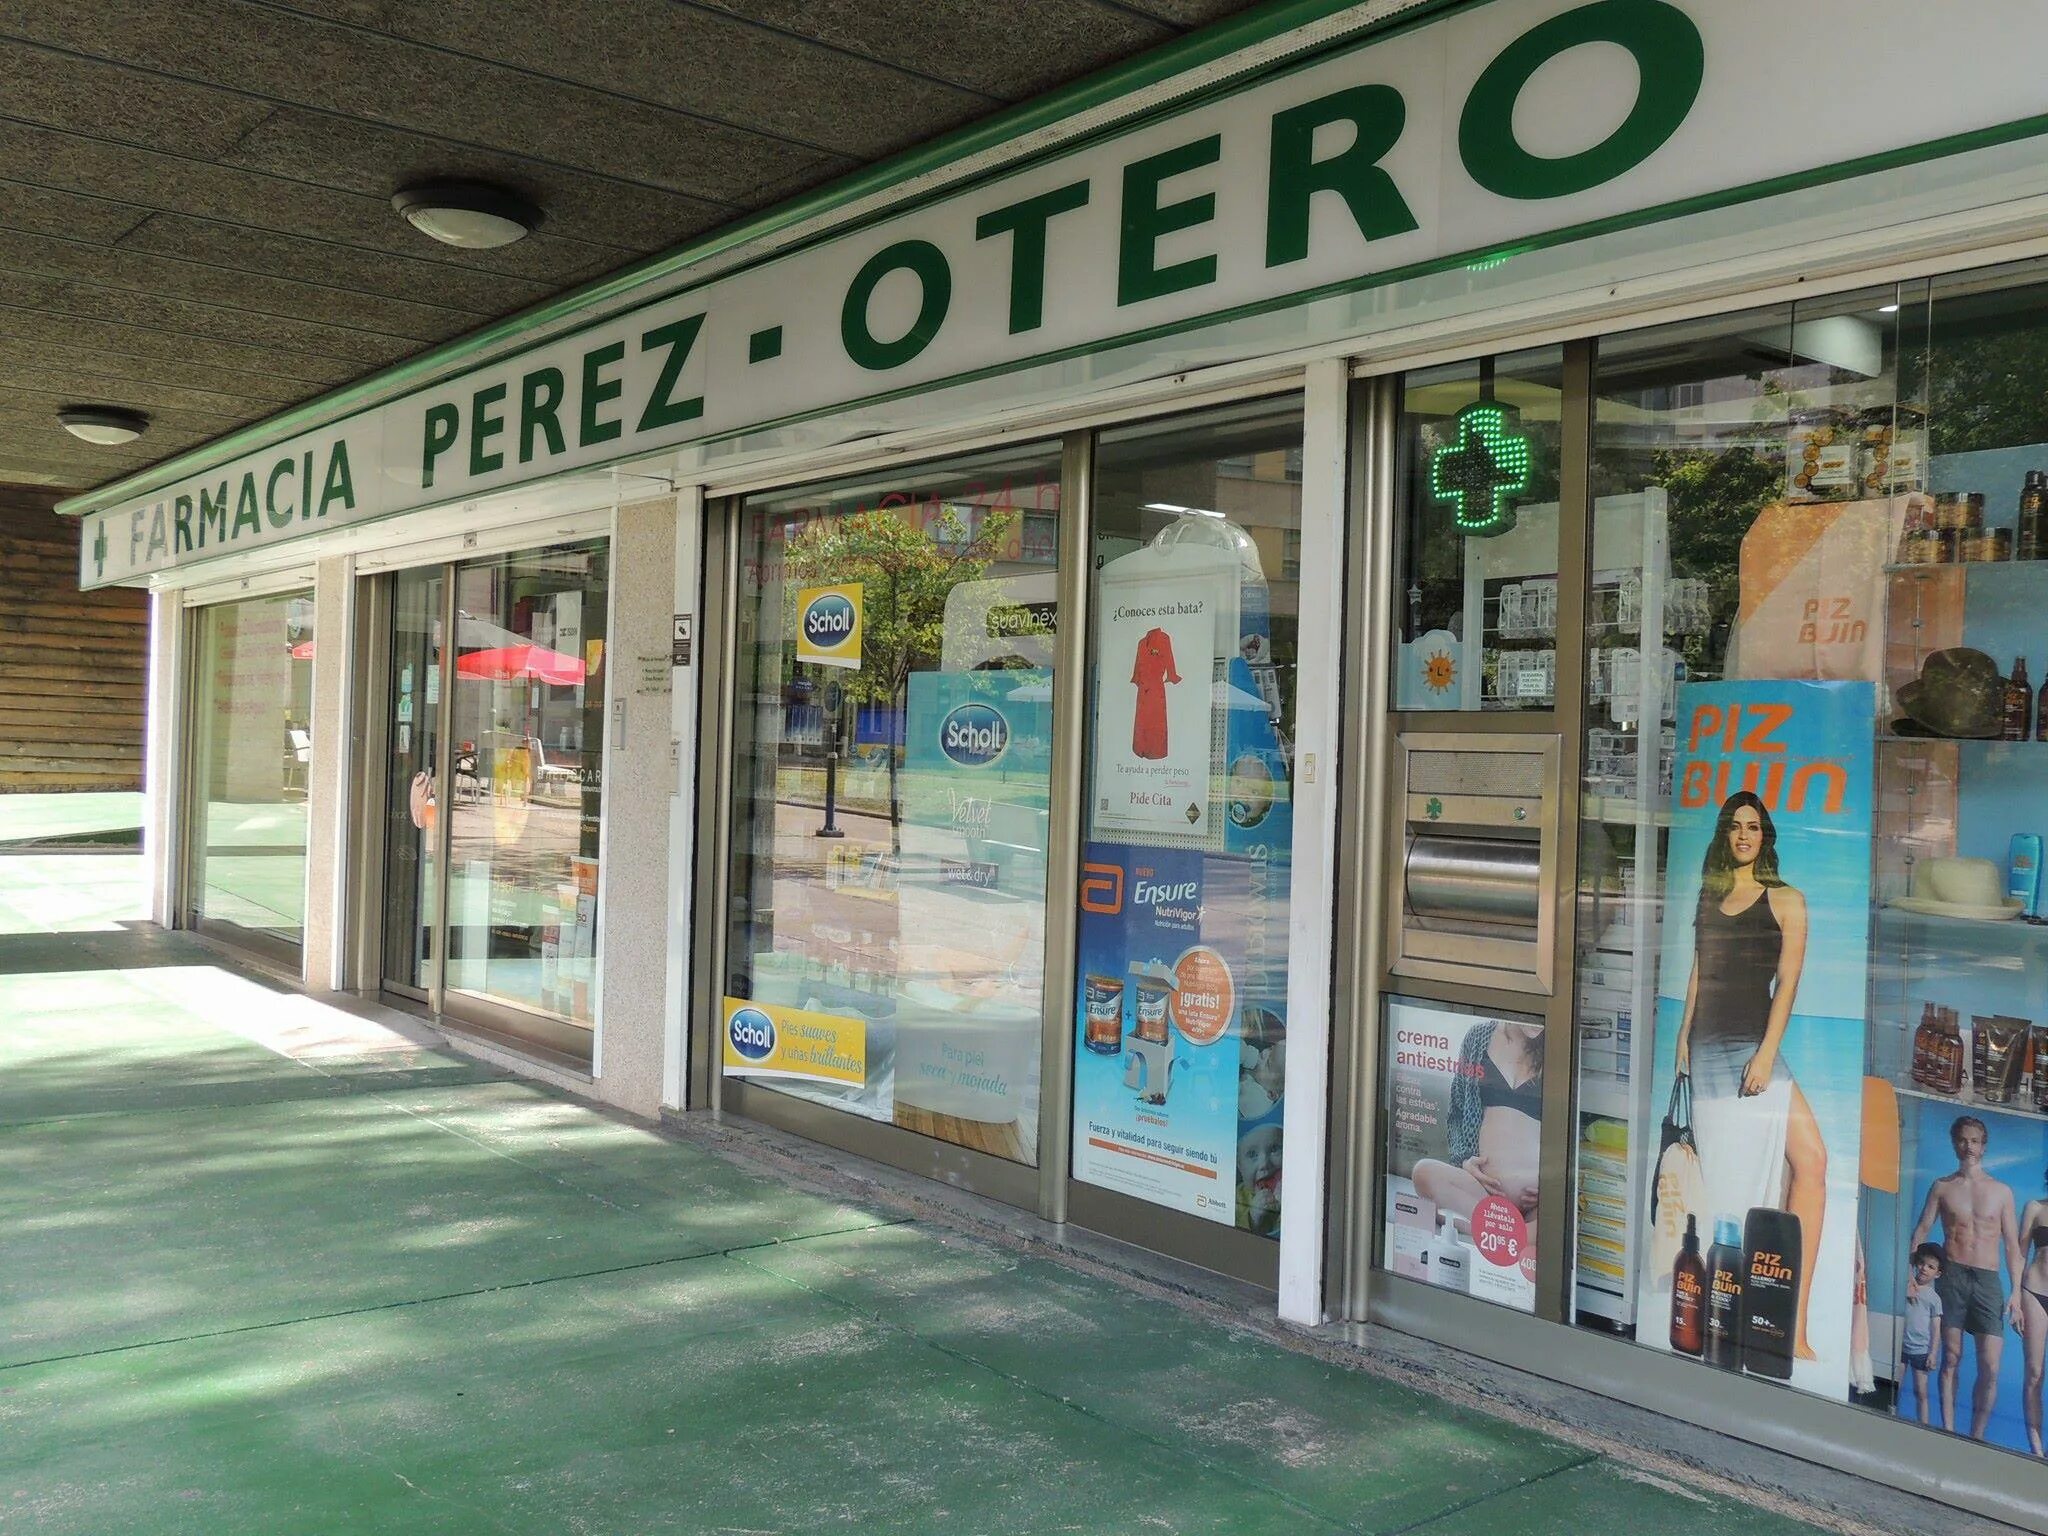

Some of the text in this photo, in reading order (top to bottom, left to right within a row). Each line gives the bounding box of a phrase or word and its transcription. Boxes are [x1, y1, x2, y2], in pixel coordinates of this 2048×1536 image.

[130, 439, 355, 566] FARMACIA
[422, 311, 707, 489] PEREZ
[841, 0, 1705, 371] OTERO
[1113, 601, 1203, 622] ¿Conoces esta bata?
[1803, 598, 1851, 620] PIZ
[808, 609, 850, 634] Scholl
[947, 720, 1001, 750] Scholl
[1688, 704, 1793, 753] PIZ
[1116, 764, 1124, 774] Te
[1125, 765, 1144, 776] ayuda
[1150, 766, 1172, 777] perder
[1173, 768, 1190, 778] peso
[947, 787, 992, 825] Velvet
[1129, 792, 1172, 806] Pide Cita
[1134, 881, 1197, 905] Ensure
[1155, 906, 1197, 921] NutriVigor
[1090, 1003, 1116, 1016] Ensure
[1180, 991, 1219, 1010] ¡gratis!
[1139, 1005, 1163, 1017] Ensure
[734, 1020, 771, 1048] Scholl
[781, 1019, 838, 1043] Pies suaves
[1397, 1029, 1449, 1050] crema
[780, 1045, 863, 1074] y uñas brillantes
[942, 1041, 984, 1068] Para piel
[960, 1073, 1008, 1096] mojada
[1396, 1084, 1421, 1097] contra
[1396, 1110, 1437, 1125] Agradable
[1396, 1121, 1423, 1133] aroma.
[1089, 1120, 1110, 1135] Fuerza
[1117, 1127, 1145, 1145] vitalidad
[1147, 1137, 1162, 1149] para
[1163, 1142, 1184, 1155] seguir
[1186, 1146, 1208, 1163] siendo
[1210, 1153, 1218, 1164] tú
[1753, 1251, 1781, 1266] PIZ
[1679, 1271, 1696, 1283] PIZ
[1714, 1269, 1733, 1282] PIZ
[1676, 1316, 1683, 1324] 15
[1709, 1318, 1720, 1327] 30
[1752, 1316, 1770, 1327] 50+
